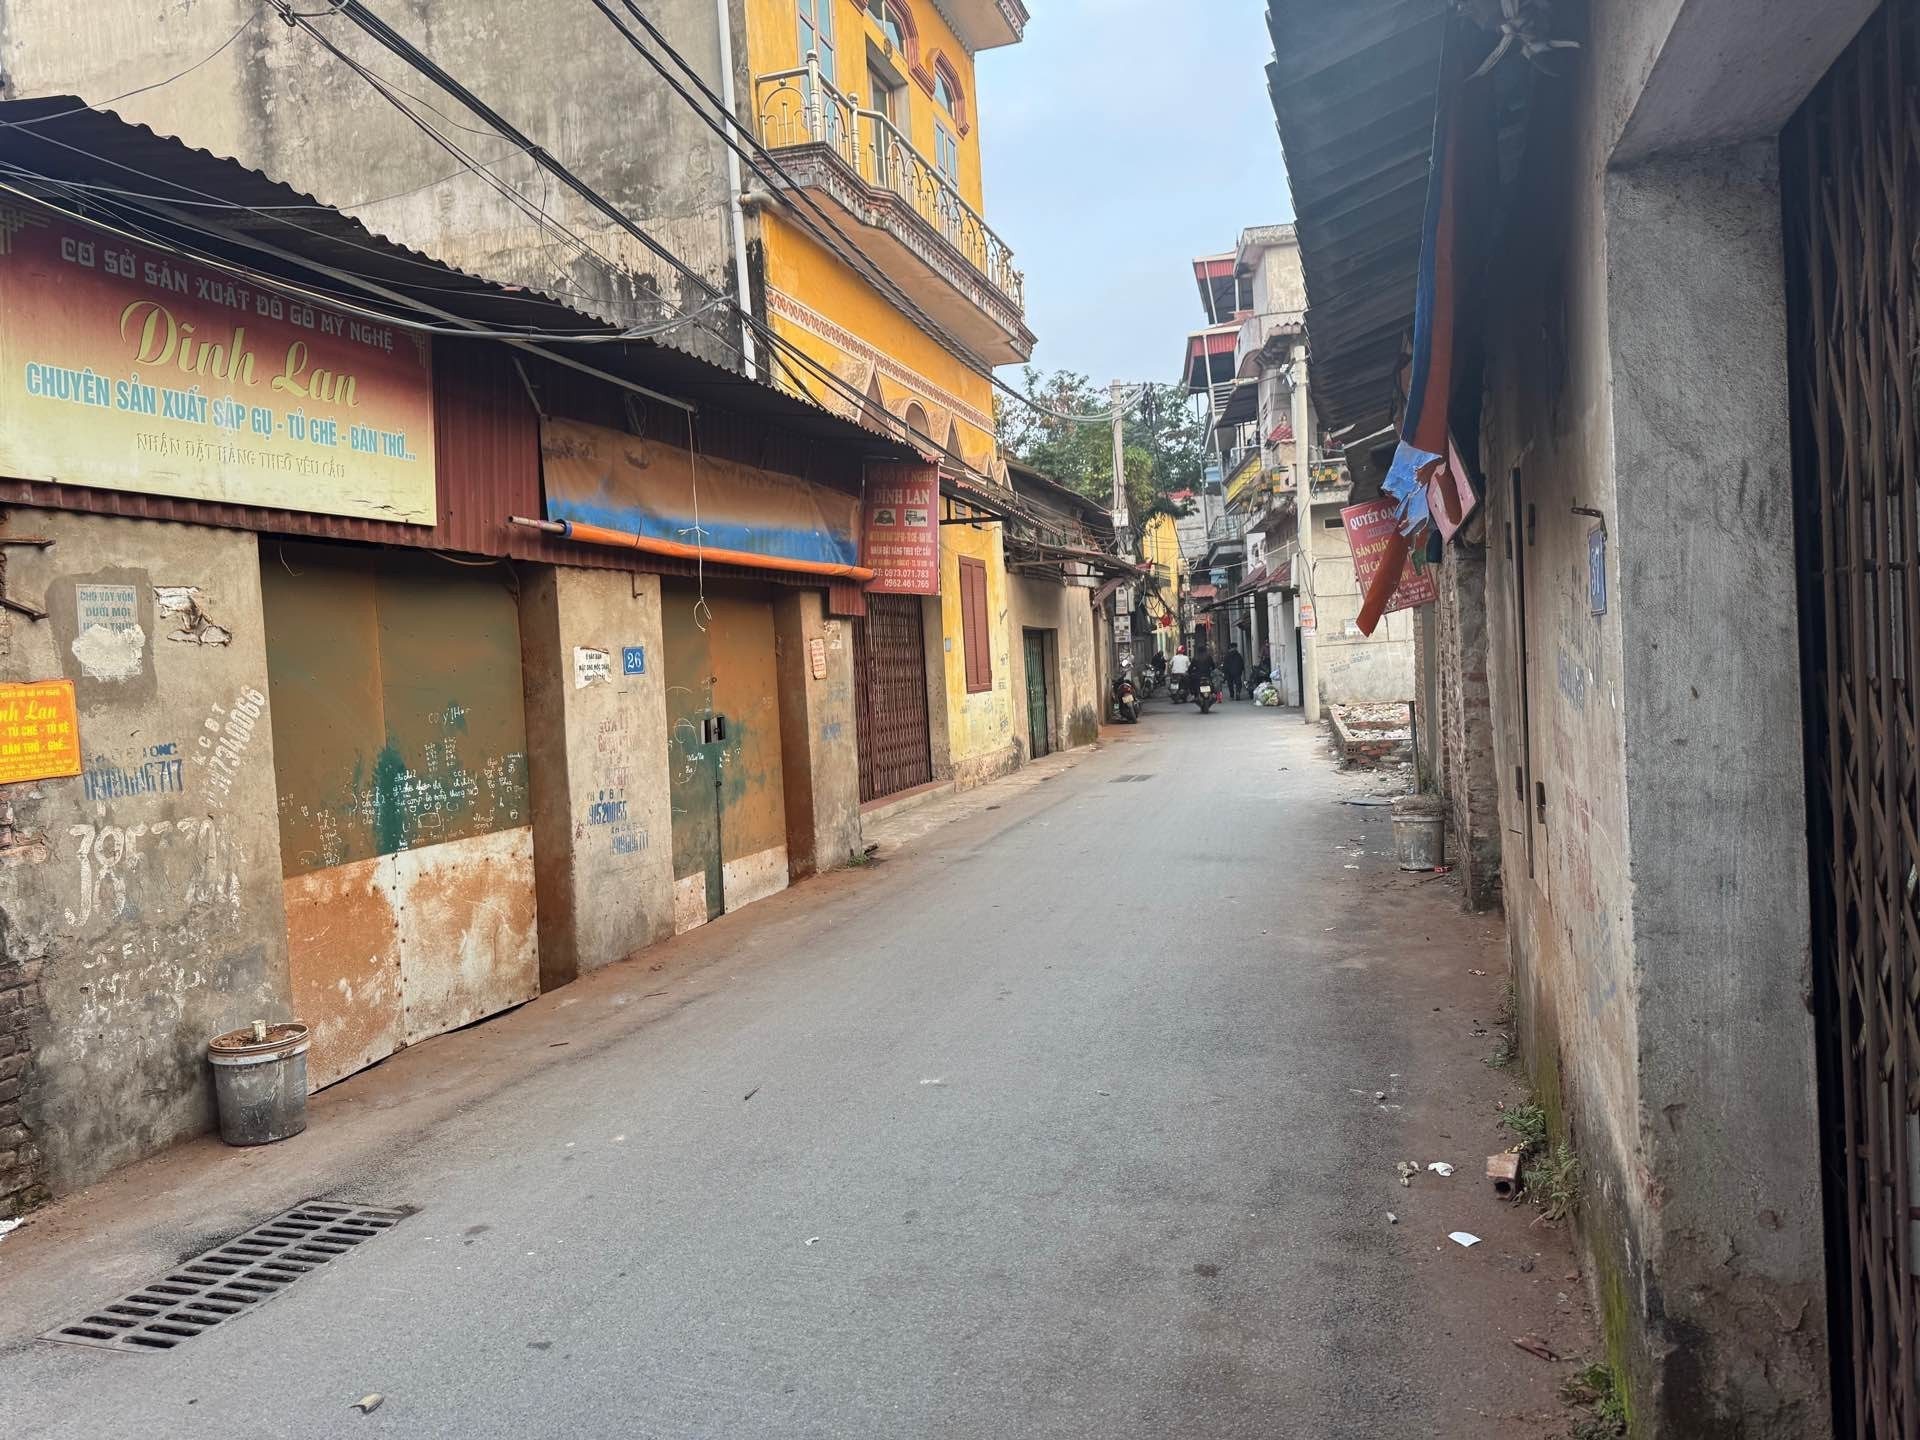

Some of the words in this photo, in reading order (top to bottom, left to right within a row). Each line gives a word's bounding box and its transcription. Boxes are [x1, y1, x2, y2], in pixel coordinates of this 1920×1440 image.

[61, 237, 95, 267] CƠ
[104, 249, 137, 279] SỞ
[144, 261, 189, 294] SẢN
[196, 277, 250, 310] XUẤT
[256, 294, 283, 321] ĐỒ
[290, 302, 315, 329] GỖ
[321, 313, 344, 336] MỸ
[350, 322, 393, 354] NGHỆ
[120, 300, 260, 386] Dĩnh
[271, 341, 359, 407] Lan
[26, 361, 111, 408] CHUYÊN
[116, 372, 157, 415] SẢN
[162, 386, 208, 424] XUẤT
[212, 397, 246, 435] SẬP
[251, 407, 273, 440] GỤ
[287, 408, 305, 441] TỦ
[350, 424, 378, 453] BÀN
[906, 489, 930, 505] LAN
[1350, 507, 1378, 530] QUYẾT
[627, 652, 642, 669] 26
